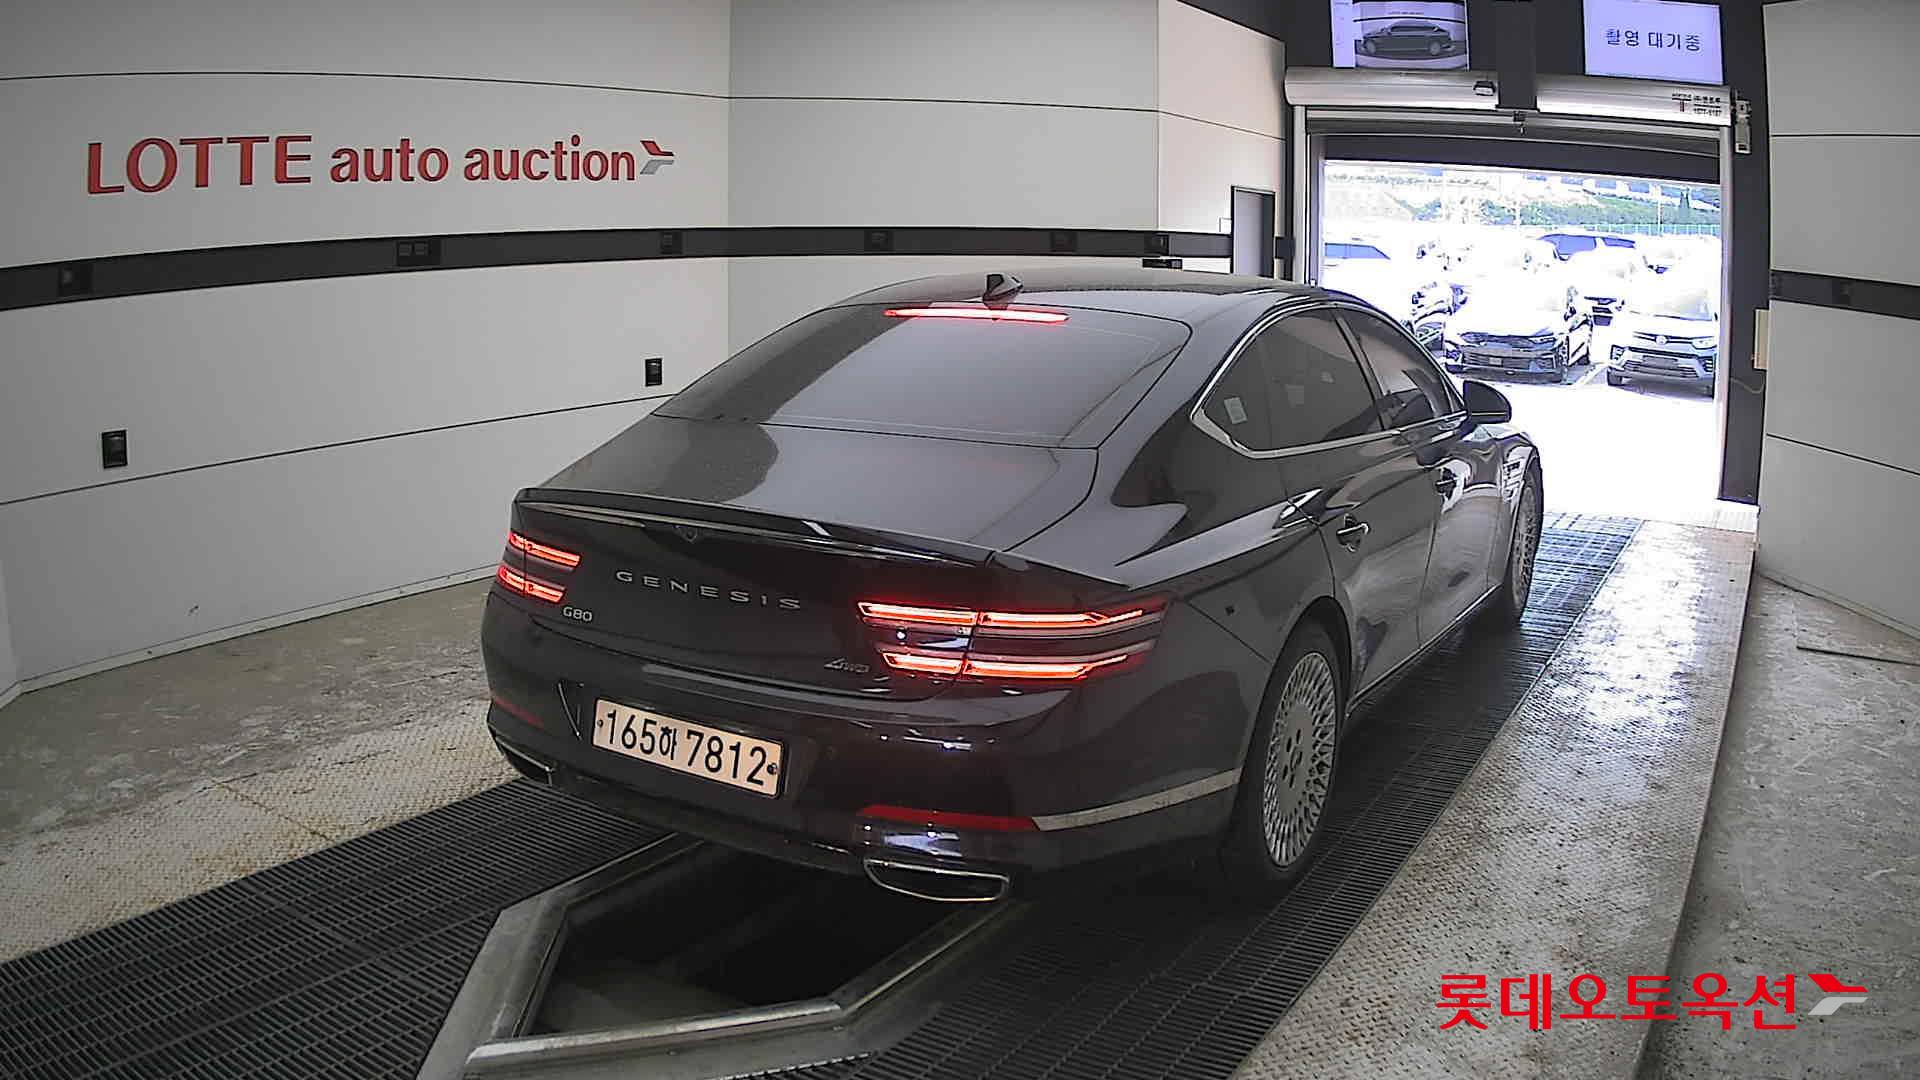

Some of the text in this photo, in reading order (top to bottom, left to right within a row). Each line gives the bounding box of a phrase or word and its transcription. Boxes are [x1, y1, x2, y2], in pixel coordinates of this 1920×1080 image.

[1648, 32, 1701, 52] 대기중
[87, 133, 636, 195] LOTTE auto auction
[615, 570, 802, 610] GENESIS
[562, 606, 594, 623] G80
[607, 709, 768, 787] 165하 7812
